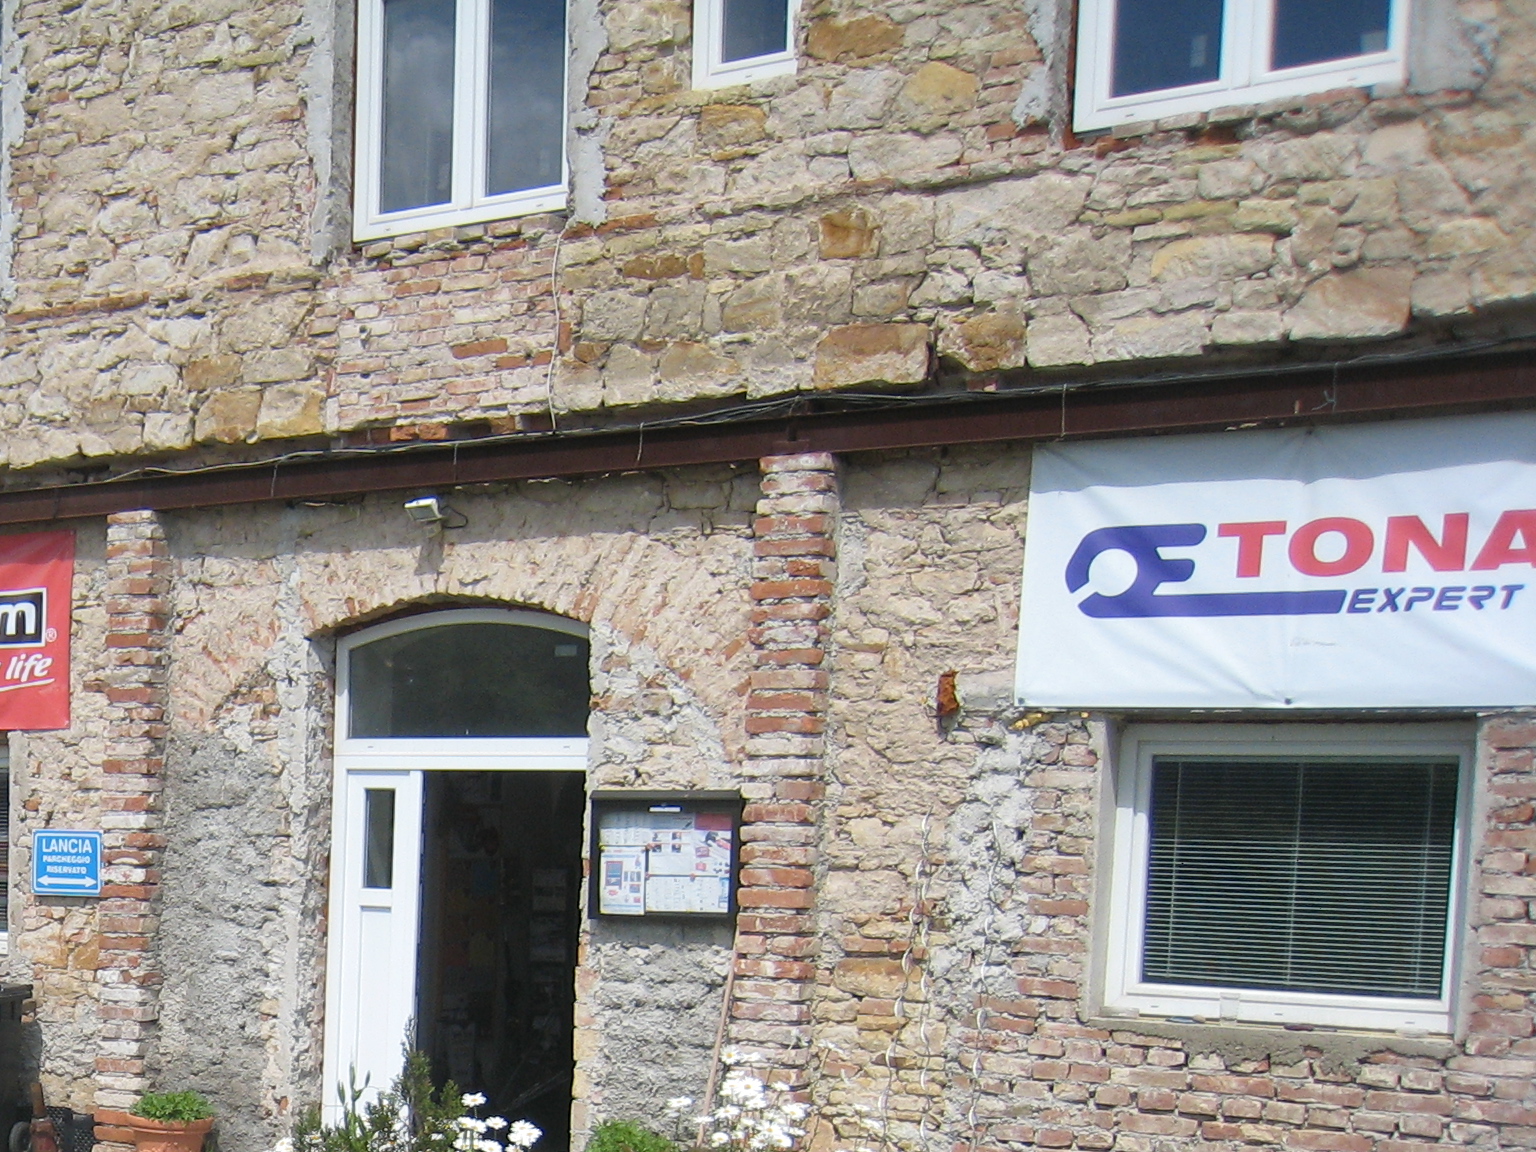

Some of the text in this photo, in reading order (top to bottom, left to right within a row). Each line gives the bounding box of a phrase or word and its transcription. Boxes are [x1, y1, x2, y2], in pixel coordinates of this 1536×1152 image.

[1217, 509, 1536, 578] TONA
[1346, 584, 1525, 613] EXPERT
[5, 654, 54, 682] life
[42, 838, 92, 853] LANCIA
[42, 855, 91, 864] PARCHEGGIO
[46, 865, 87, 874] RISERVATO
